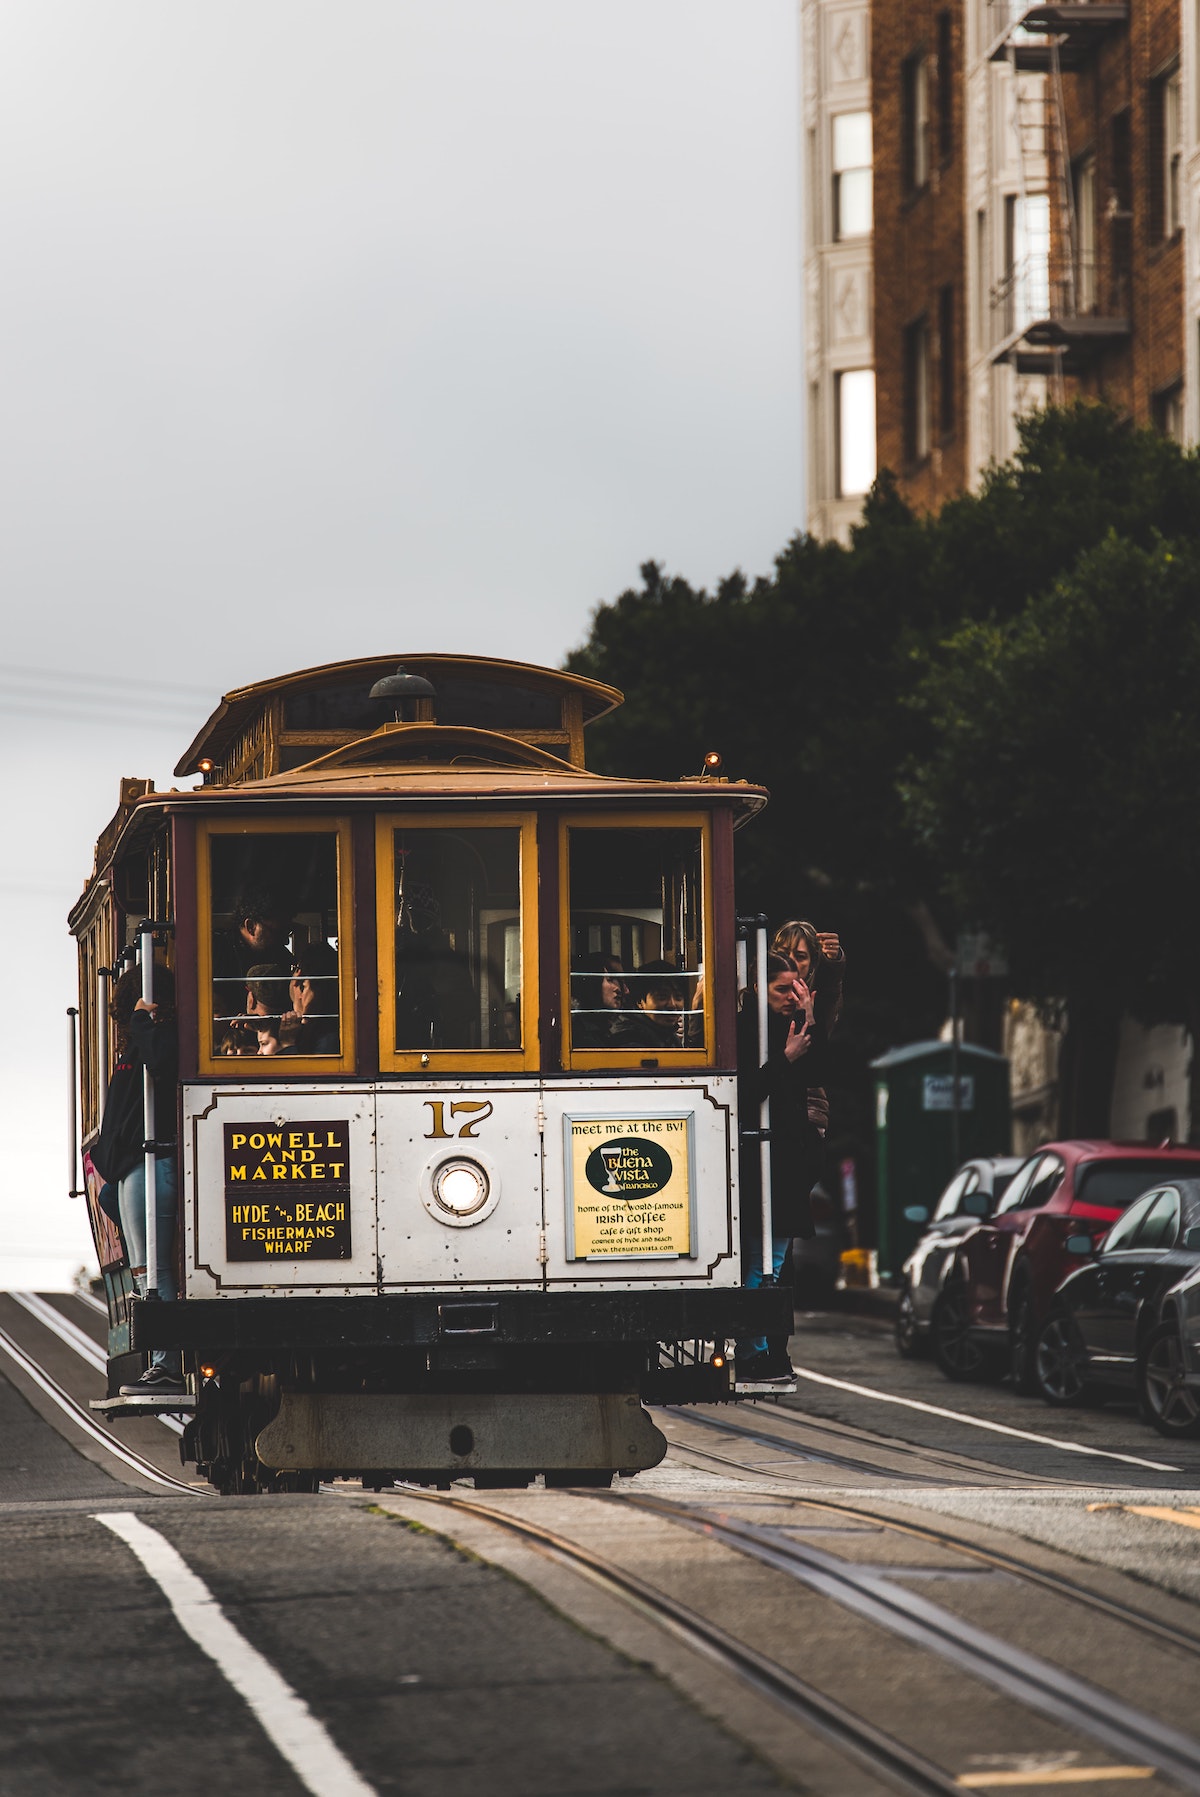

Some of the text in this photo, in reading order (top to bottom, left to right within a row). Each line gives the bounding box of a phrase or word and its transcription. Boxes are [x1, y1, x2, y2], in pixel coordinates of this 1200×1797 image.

[423, 1100, 493, 1138] 17
[572, 1121, 683, 1135] meet me at the BV!
[232, 1132, 342, 1150] POWELL
[261, 1150, 316, 1163] AND
[622, 1147, 640, 1156] the
[230, 1163, 344, 1181] MARKET
[232, 1203, 345, 1224] HYDE AND BEACH
[577, 1204, 600, 1213] home
[601, 1204, 611, 1213] of
[612, 1204, 626, 1212] the
[242, 1226, 335, 1241] FISHERMANS
[643, 1226, 664, 1235] shop
[265, 1241, 313, 1254] WHARF
